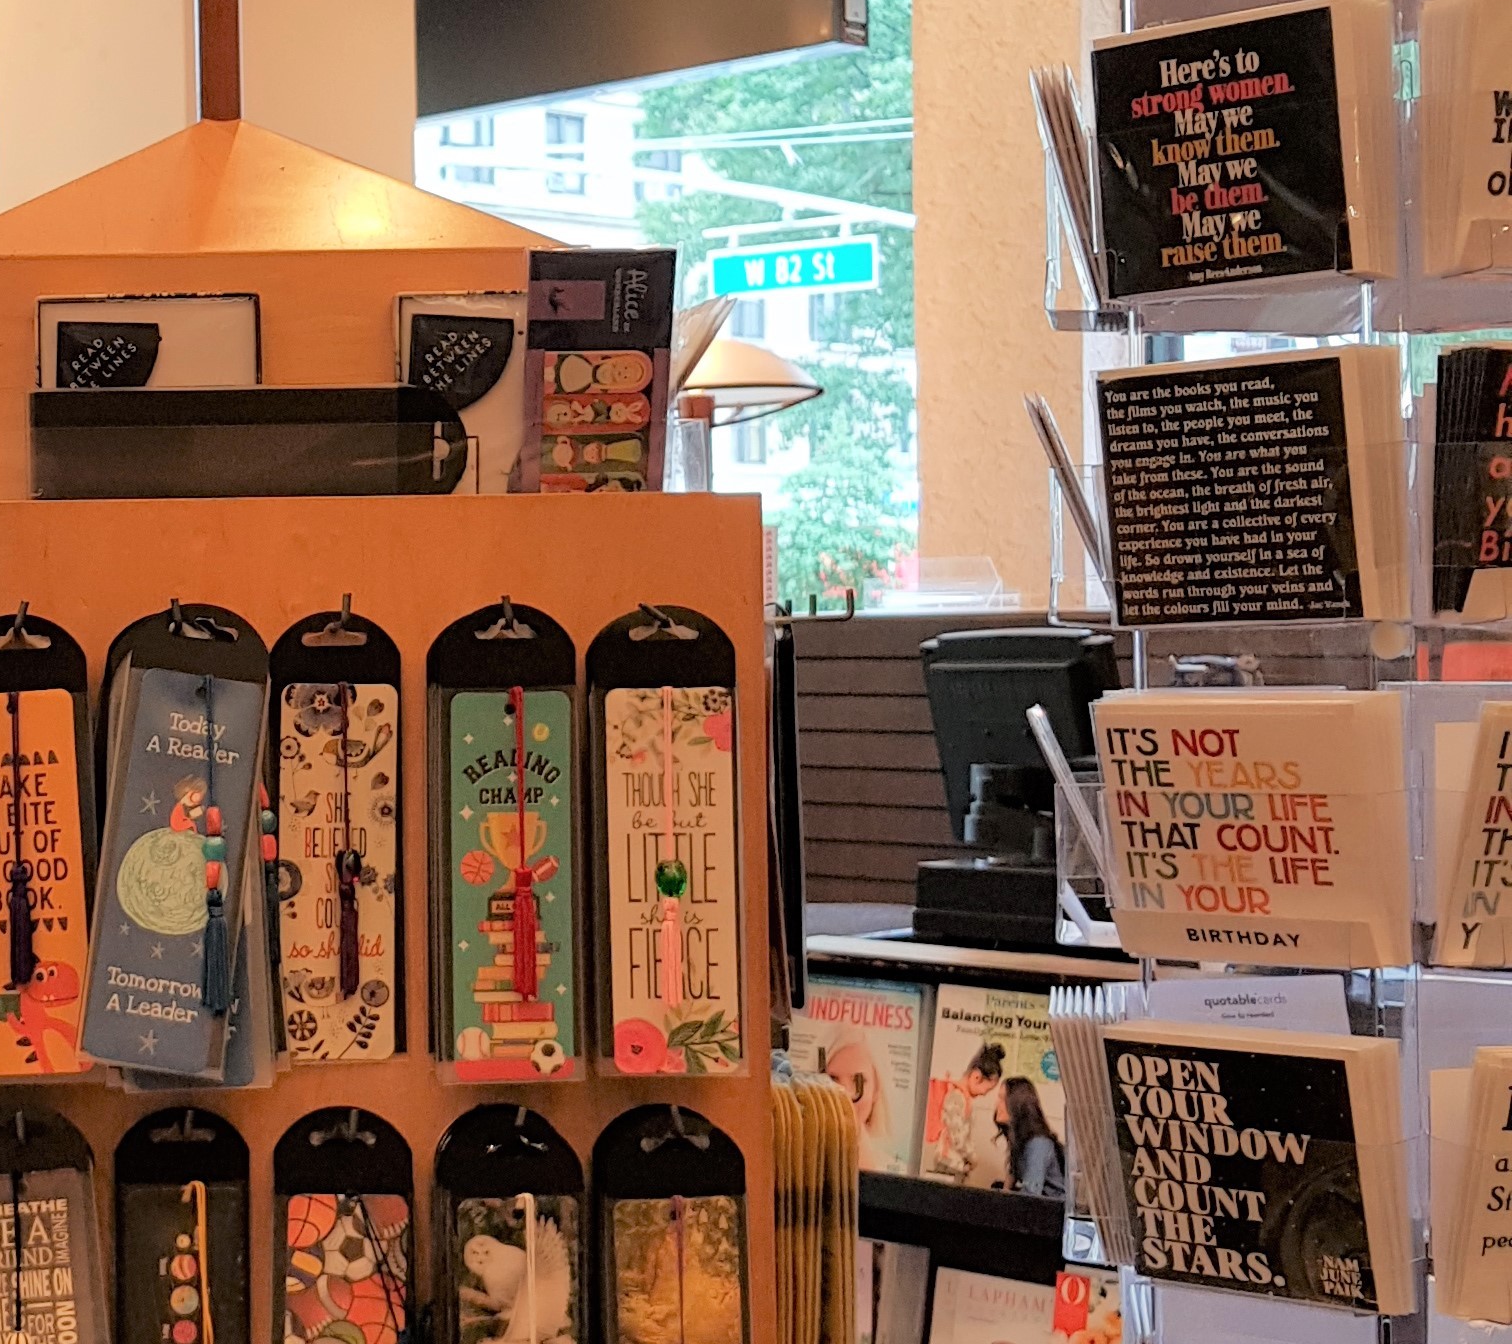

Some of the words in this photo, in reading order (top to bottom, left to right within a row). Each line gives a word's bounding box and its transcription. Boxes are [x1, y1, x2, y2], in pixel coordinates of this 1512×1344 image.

[1159, 50, 1230, 88] Here's
[1234, 47, 1260, 74] to
[1130, 82, 1203, 120] strong
[1210, 71, 1295, 104] women.
[1174, 109, 1221, 141] May
[1222, 105, 1253, 127] we
[1152, 135, 1211, 167] know
[1215, 125, 1280, 156] them.
[1177, 157, 1221, 191] May
[1226, 156, 1257, 180] we
[1171, 187, 1200, 215] be
[1204, 182, 1268, 209] them.
[1182, 209, 1226, 242] May
[1231, 207, 1261, 230] we
[1161, 240, 1217, 268] raise
[1222, 230, 1287, 259] them.
[744, 258, 765, 286] W
[775, 254, 802, 285] 82
[812, 251, 835, 281] St
[624, 269, 648, 320] Alice
[70, 336, 124, 388] BETWEEN
[71, 338, 103, 370] READ
[102, 344, 137, 378] LINES
[1105, 391, 1127, 404] You
[1130, 391, 1149, 400] are
[1152, 386, 1171, 399] the
[1174, 382, 1211, 397] books
[1214, 382, 1237, 395] you
[1241, 377, 1275, 391] read,
[1107, 407, 1125, 419] the
[1127, 405, 1157, 421] films
[1160, 404, 1182, 417] you
[1185, 399, 1227, 414] watch,
[1230, 394, 1250, 408] the
[1253, 392, 1291, 406] music
[1295, 391, 1318, 404] you
[169, 711, 225, 740] Today
[1106, 728, 1159, 756] IT'S
[1172, 728, 1240, 757] NOT
[146, 736, 160, 754] A
[167, 737, 239, 765] Reader
[689, 772, 716, 806] SHE
[1112, 759, 1174, 788] THE
[1188, 761, 1300, 790] YEARS
[479, 787, 544, 805] CHAMP
[1117, 790, 1150, 818] IN
[1162, 792, 1255, 821] YOUR
[1269, 794, 1333, 823] LIFE
[34, 829, 62, 853] OF
[1121, 820, 1201, 849] THAT
[1217, 823, 1340, 855] COUNT.
[1125, 850, 1178, 880] IT'S
[1192, 854, 1258, 884] THE
[1270, 857, 1334, 887] LIFE
[1132, 881, 1165, 909] IN
[1177, 883, 1270, 915] YOUR
[1187, 927, 1299, 948] BIRTHDAY
[106, 994, 123, 1013] A
[126, 996, 198, 1024] Leader
[941, 1006, 1013, 1029] Balancing
[1015, 1015, 1050, 1030] Your
[1117, 1053, 1221, 1093] OPEN
[1118, 1082, 1234, 1126] YOUR
[1124, 1114, 1311, 1165] WINDOW
[1131, 1147, 1211, 1185] AND
[1133, 1176, 1266, 1222] COUNT
[1136, 1206, 1217, 1246] THE
[1142, 1237, 1286, 1287] STARS.
[1319, 1268, 1362, 1288] JUNE
[1322, 1255, 1359, 1272] NAM
[1323, 1278, 1364, 1299] PAIK
